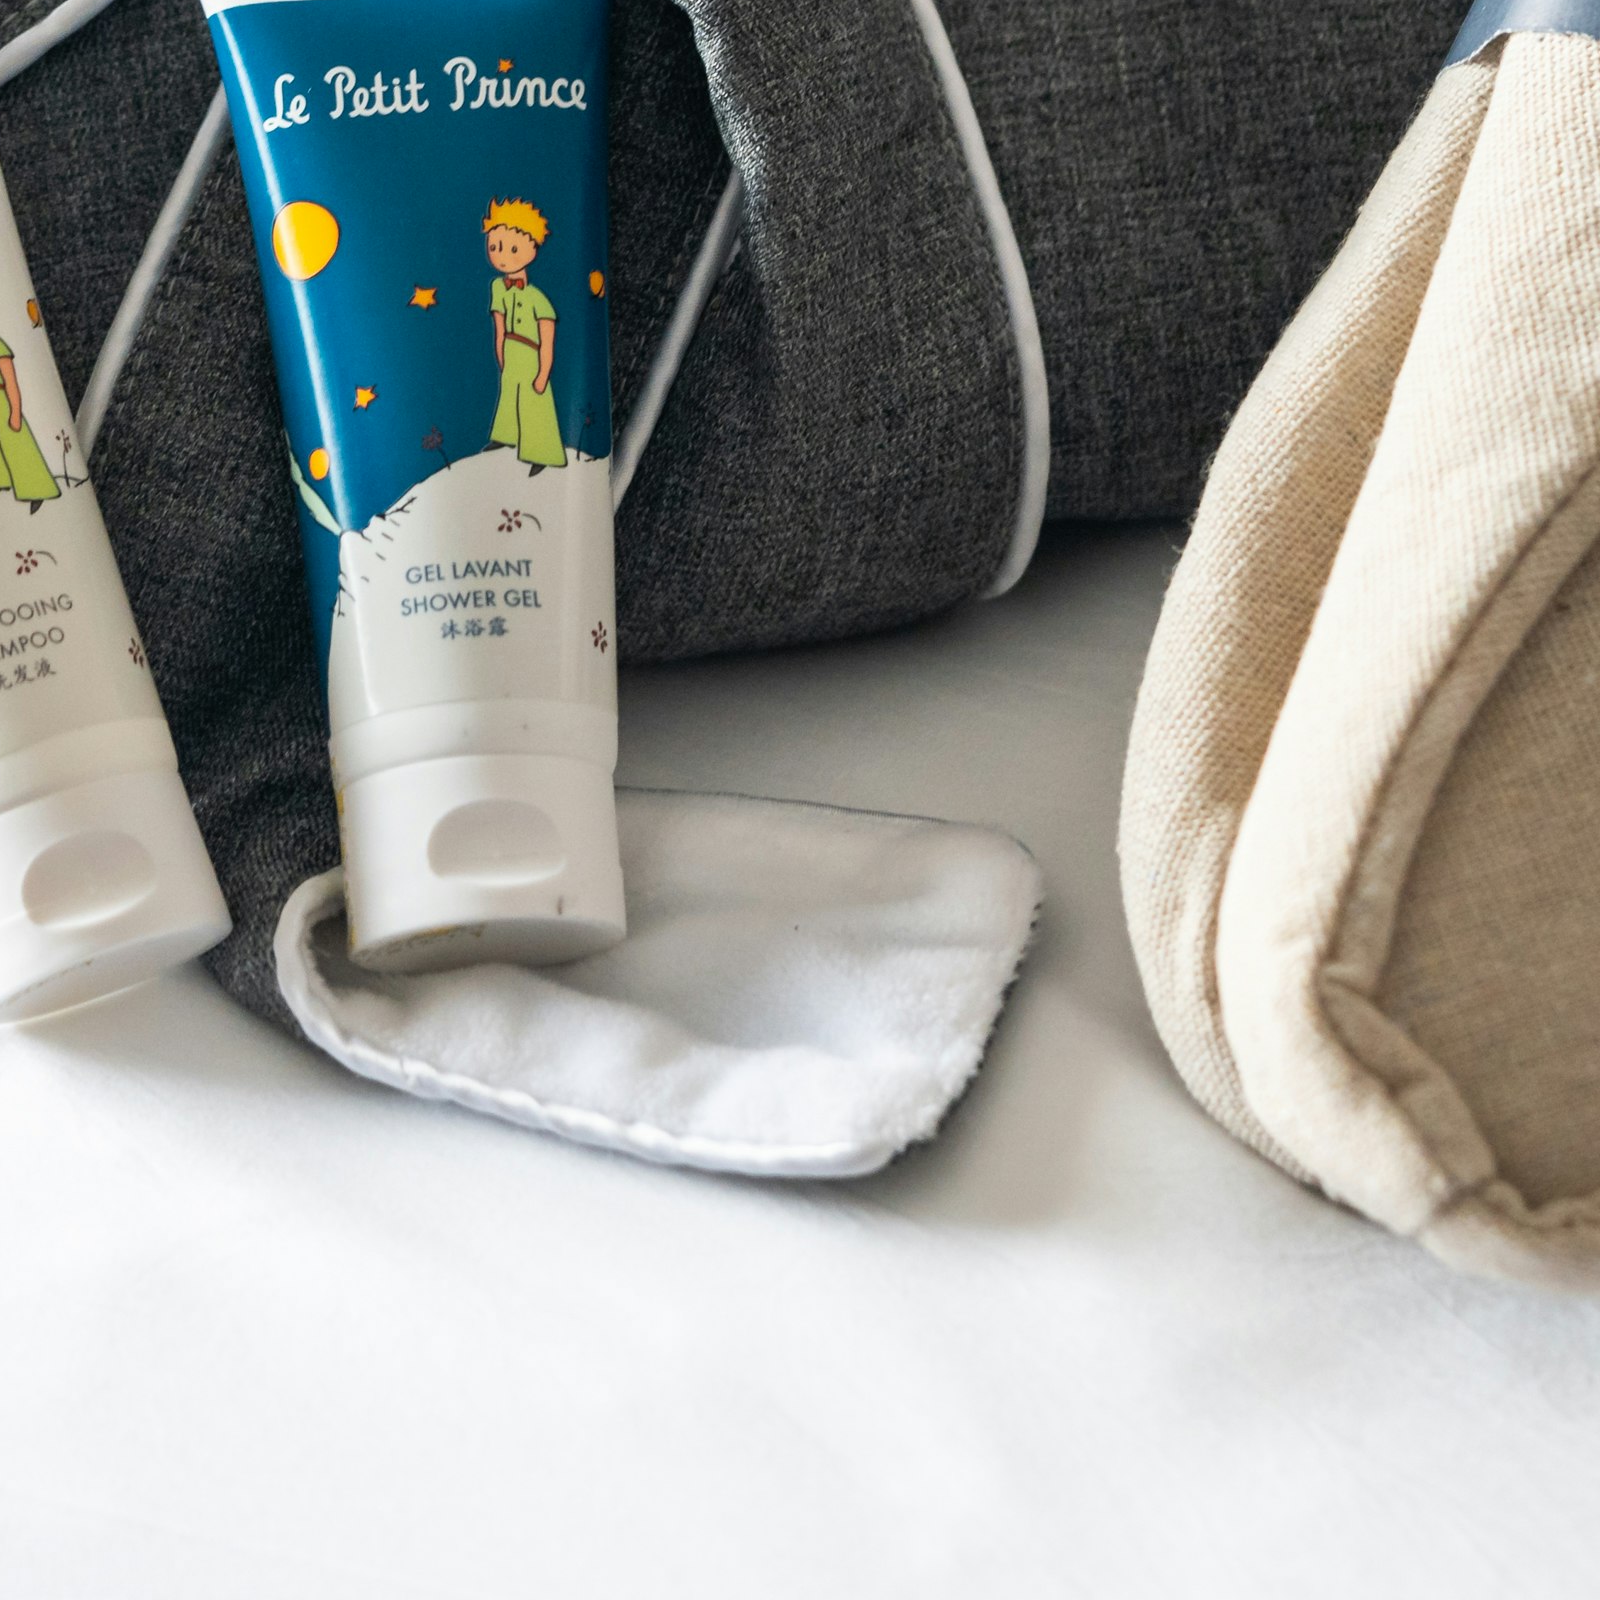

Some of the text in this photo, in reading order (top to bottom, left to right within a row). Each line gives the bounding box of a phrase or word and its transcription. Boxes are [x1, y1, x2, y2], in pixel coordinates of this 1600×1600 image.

[262, 56, 588, 134] Le Petit Prince
[404, 558, 533, 585] GEL LAVANT
[400, 588, 543, 617] SHOWER GEL
[439, 616, 510, 641] 沐浴露
